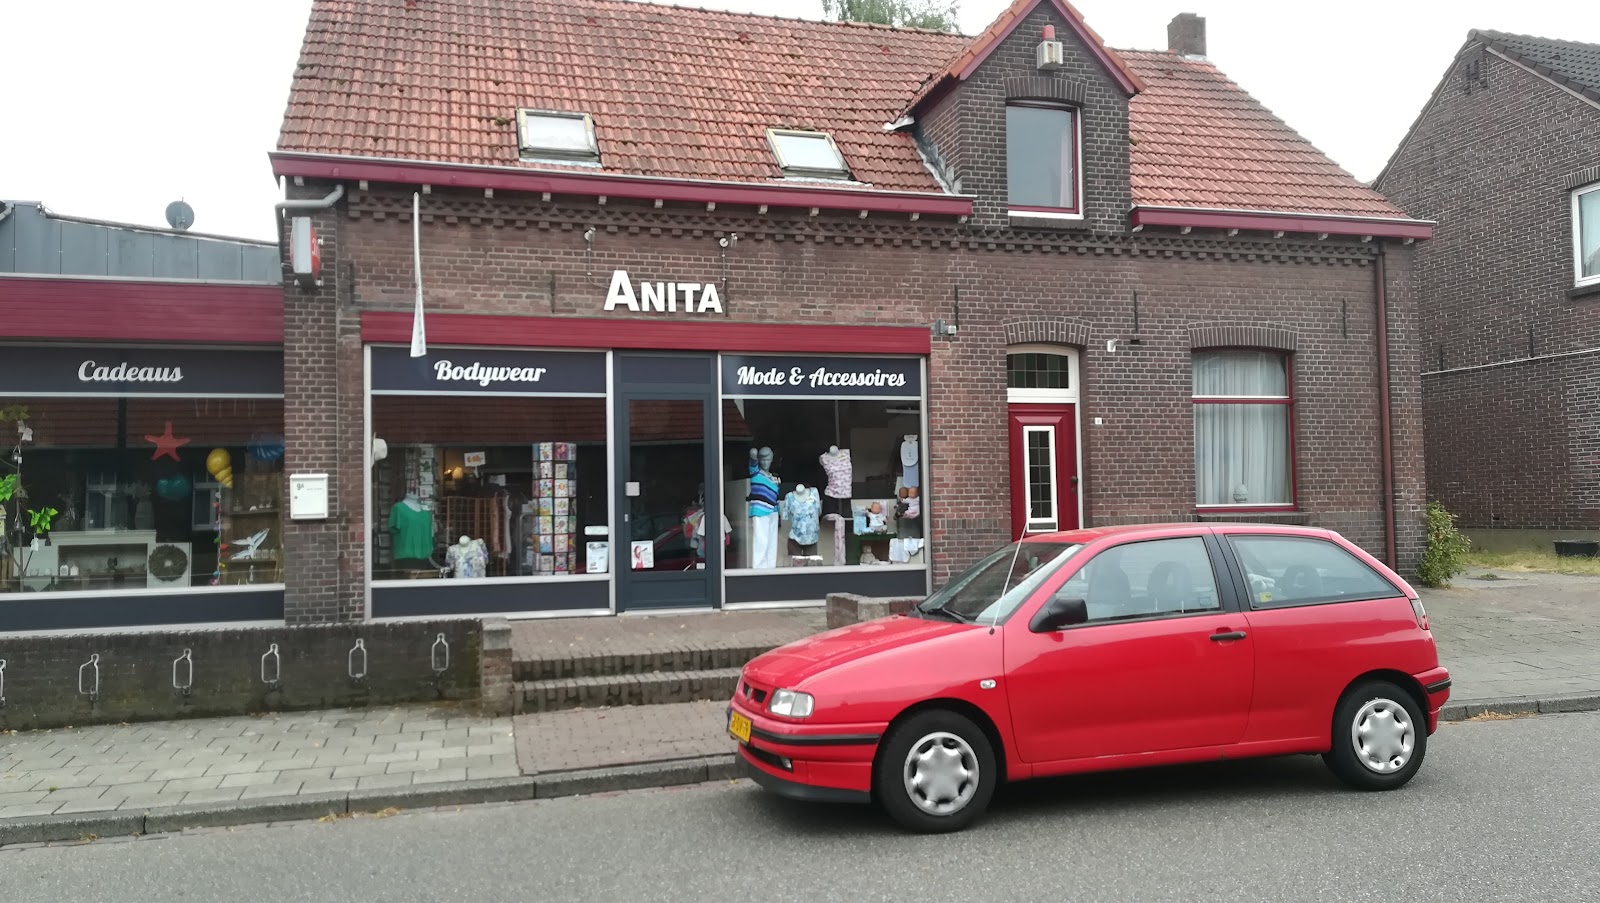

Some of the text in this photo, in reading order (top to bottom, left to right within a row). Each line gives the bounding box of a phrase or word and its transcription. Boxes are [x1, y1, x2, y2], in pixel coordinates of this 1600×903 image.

[603, 270, 722, 313] ANITA
[77, 360, 184, 382] Cadeaus
[433, 359, 547, 387] Bodywear
[736, 366, 907, 388] Mode & Accessoires
